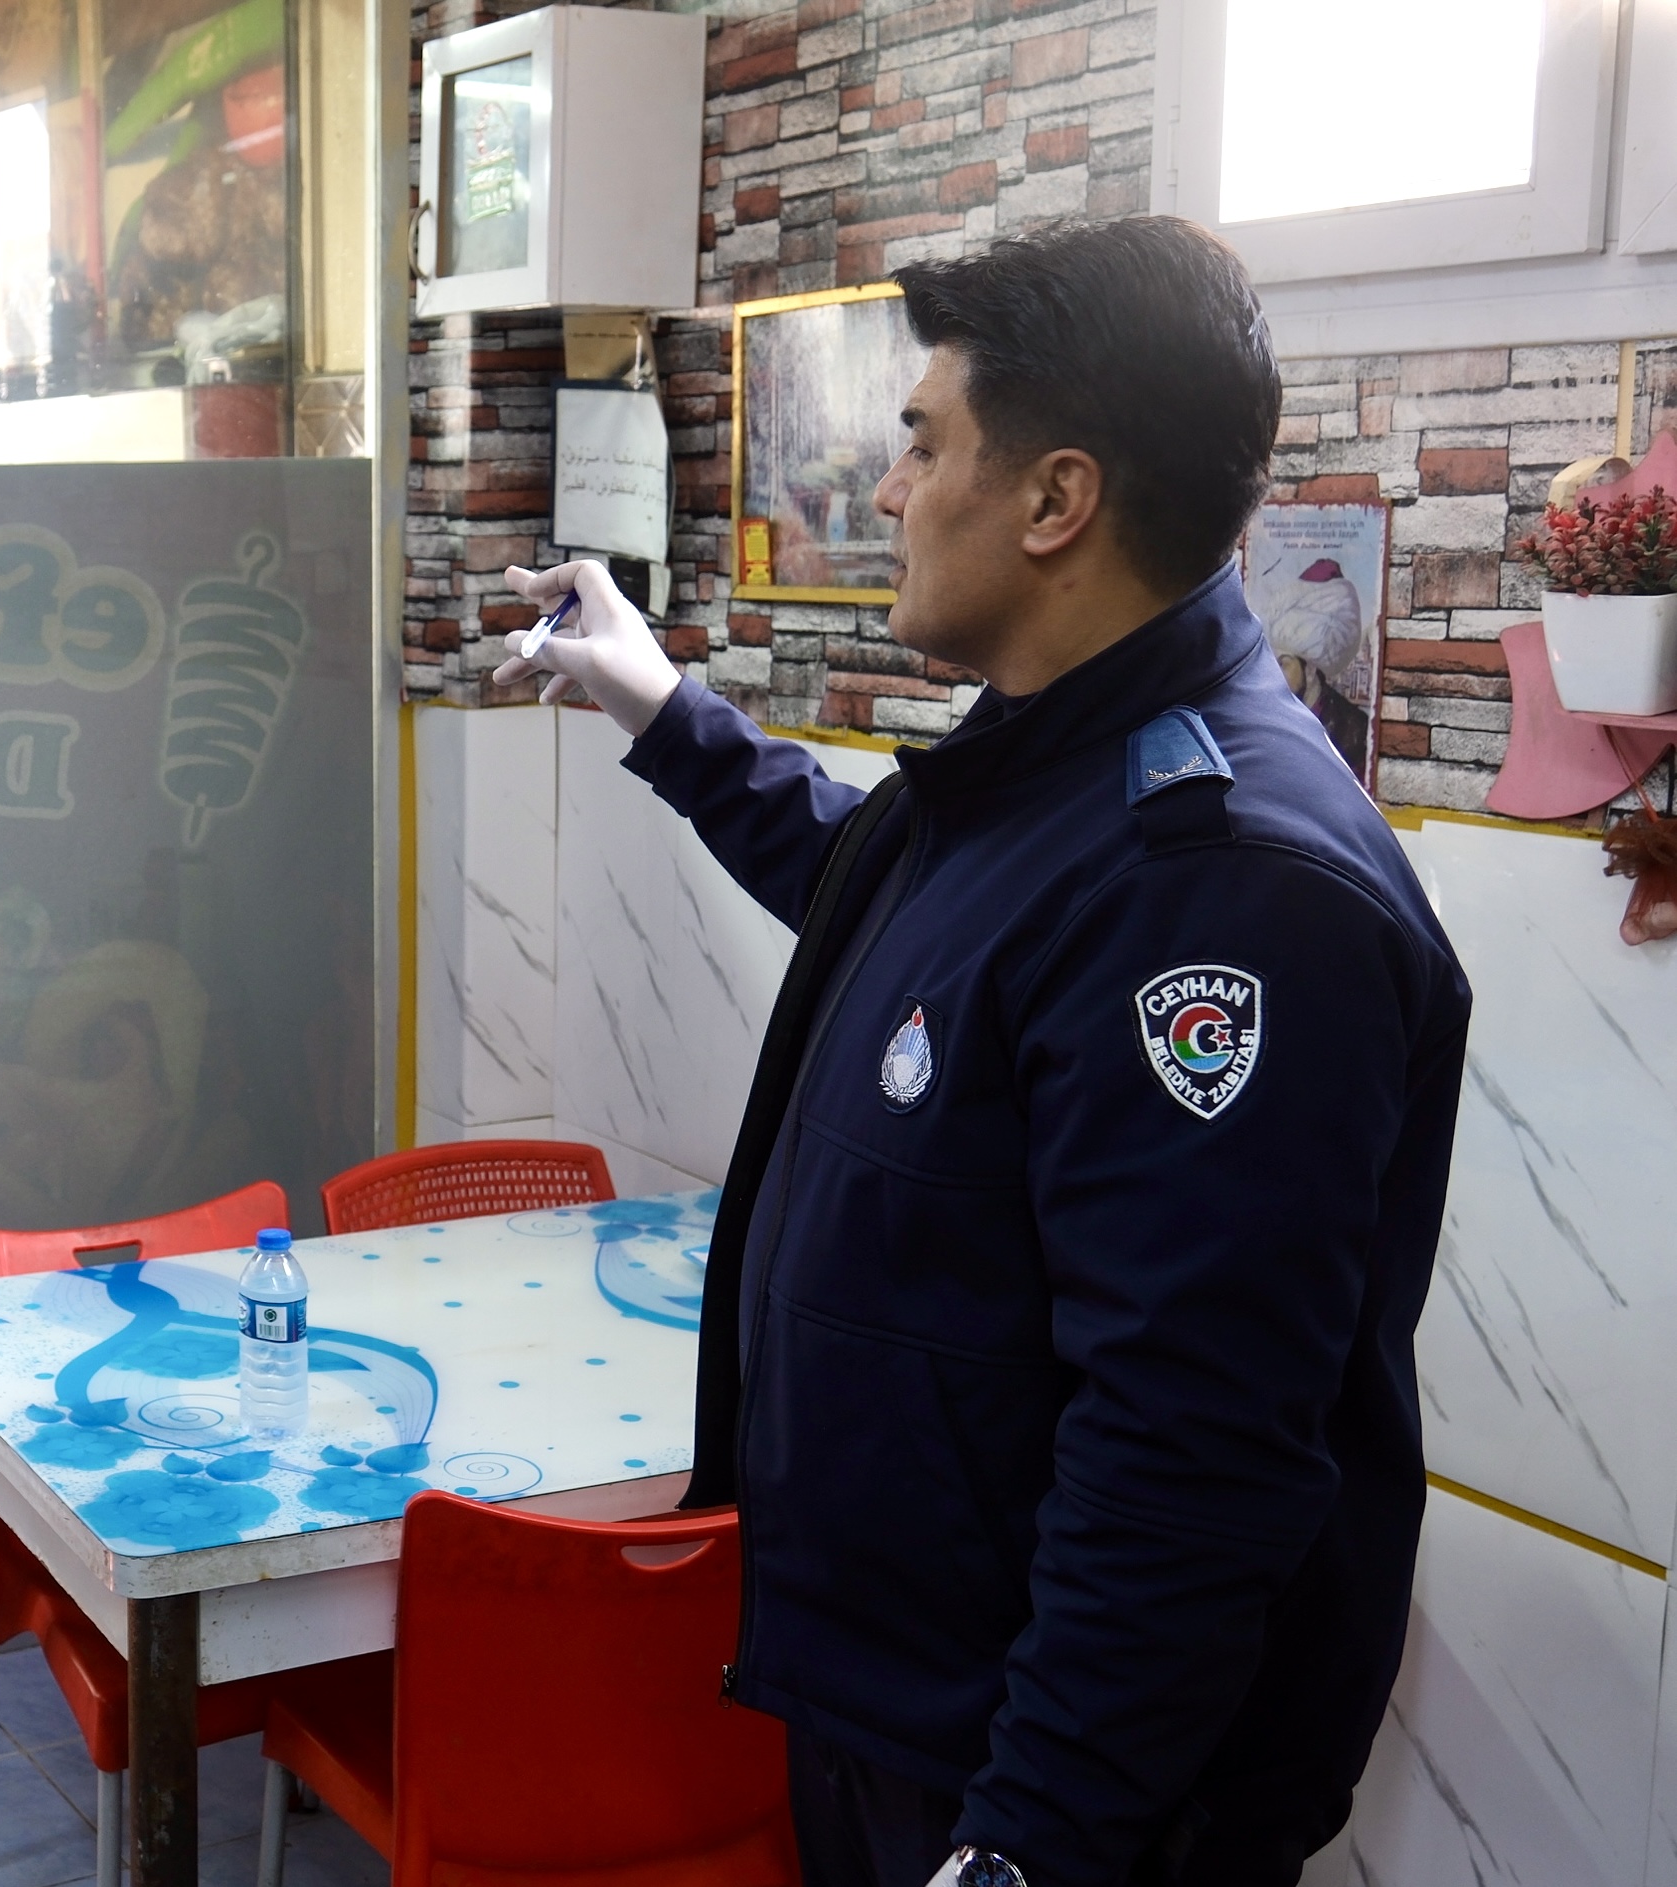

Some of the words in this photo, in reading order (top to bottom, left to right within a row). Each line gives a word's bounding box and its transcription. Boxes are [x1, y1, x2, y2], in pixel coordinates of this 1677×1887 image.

[1145, 975, 1250, 1017] CEYHAN
[1149, 1035, 1207, 1105] BELEDİYE
[1207, 1029, 1255, 1104] ZABITASI
